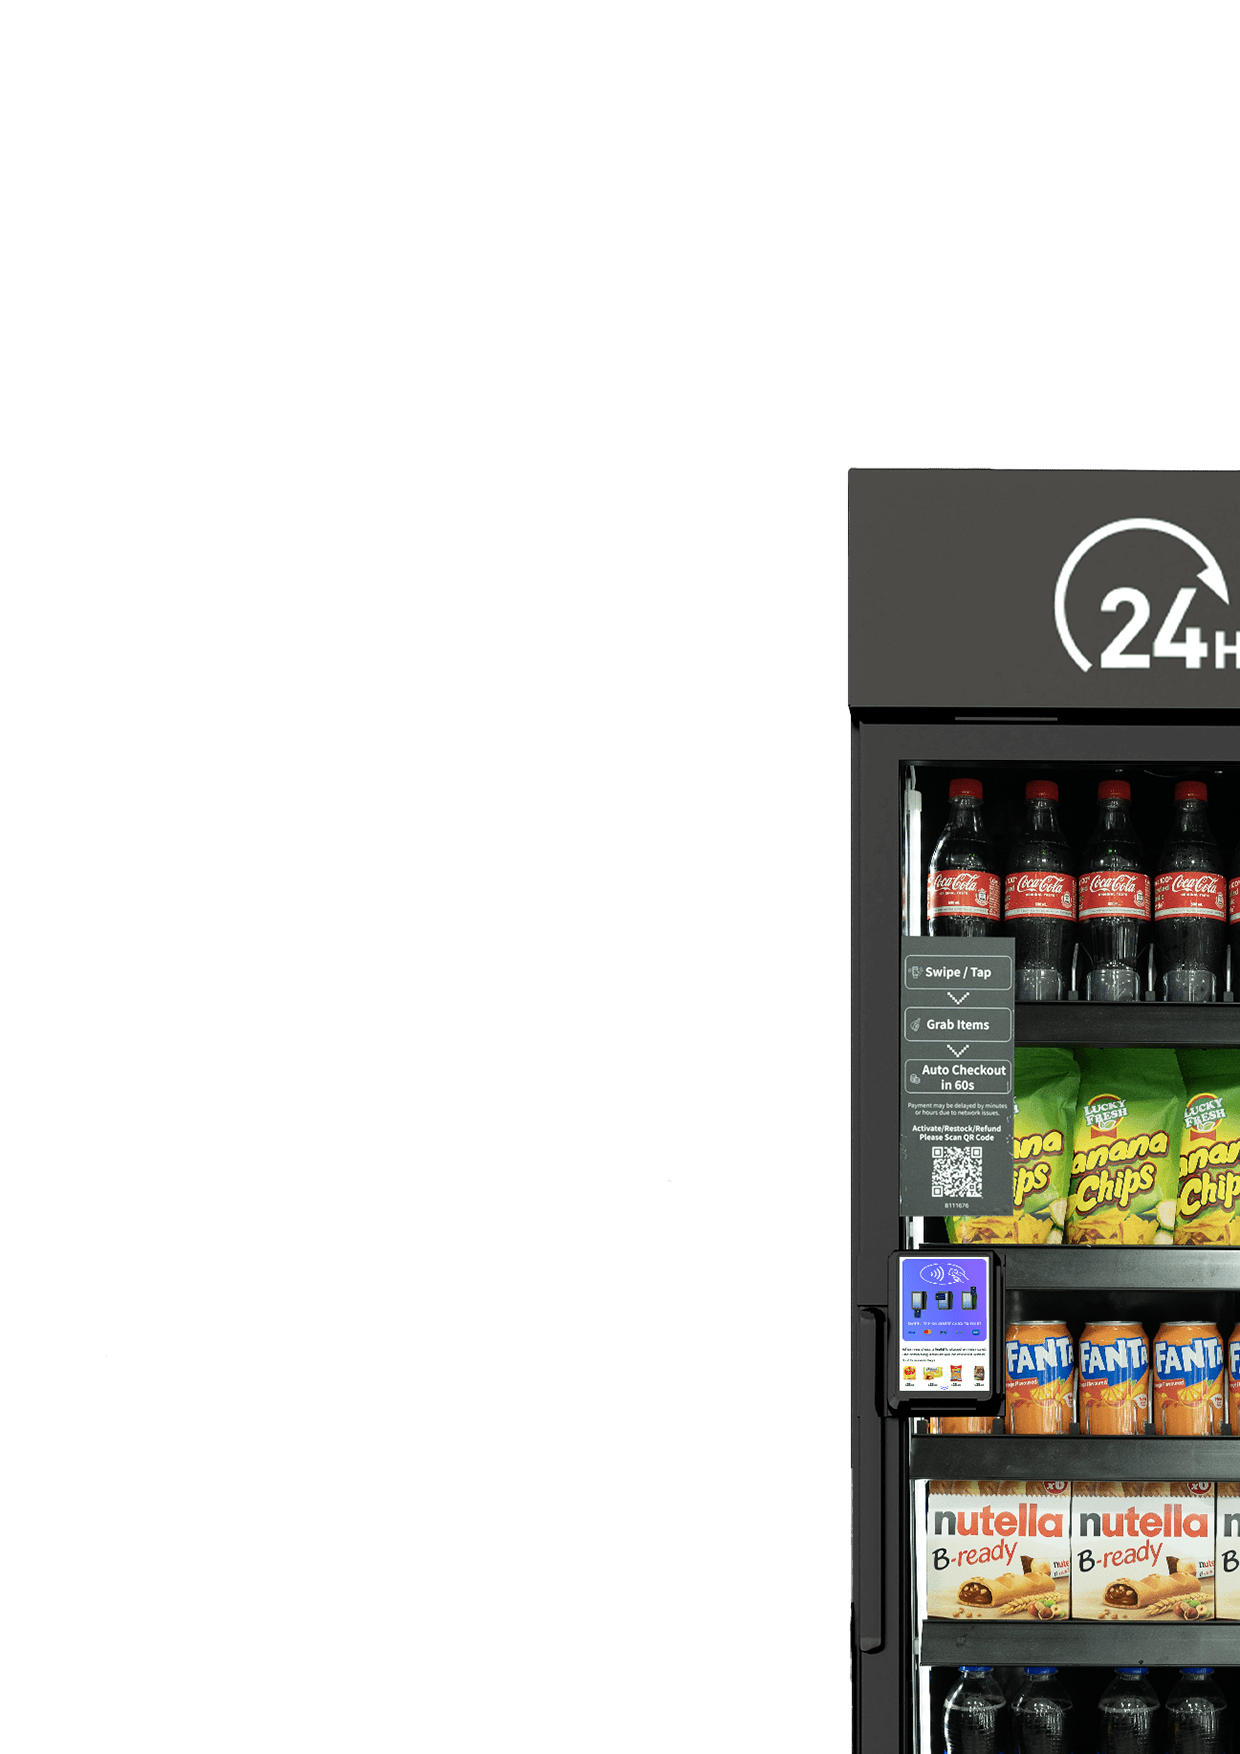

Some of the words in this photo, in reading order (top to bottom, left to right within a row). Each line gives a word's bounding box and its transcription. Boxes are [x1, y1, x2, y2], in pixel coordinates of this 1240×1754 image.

[1017, 875, 1065, 893] Coca-Cola
[1090, 874, 1138, 892] Coca-Cola
[1172, 875, 1219, 893] Coca-Cola
[925, 966, 961, 981] Swipe
[963, 966, 968, 980] /
[970, 966, 992, 981] Tap
[926, 1018, 955, 1031] Grab
[957, 1019, 990, 1031] Items
[922, 1064, 949, 1076] Auto
[952, 1063, 1007, 1076] Checkout
[941, 1079, 952, 1091] in
[954, 1079, 975, 1091] 60s
[1084, 1100, 1126, 1116] LUCKY
[1086, 1107, 1128, 1126] FRESH
[1184, 1098, 1223, 1118] LUCKY
[1184, 1108, 1226, 1129] FRESH
[912, 1124, 1002, 1133] Activate/Restock/Refund
[919, 1133, 944, 1141] Please
[944, 1133, 962, 1141] Scan
[963, 1134, 975, 1143] QR
[975, 1133, 995, 1141] Code
[1076, 1162, 1157, 1214] Chips
[1080, 1338, 1147, 1374] FANTA
[934, 1503, 1063, 1538] nutella
[1080, 1504, 1208, 1538] nutella
[931, 1538, 1018, 1571] B-ready
[1077, 1539, 1163, 1572] B-ready
[1053, 1560, 1070, 1569] nute
